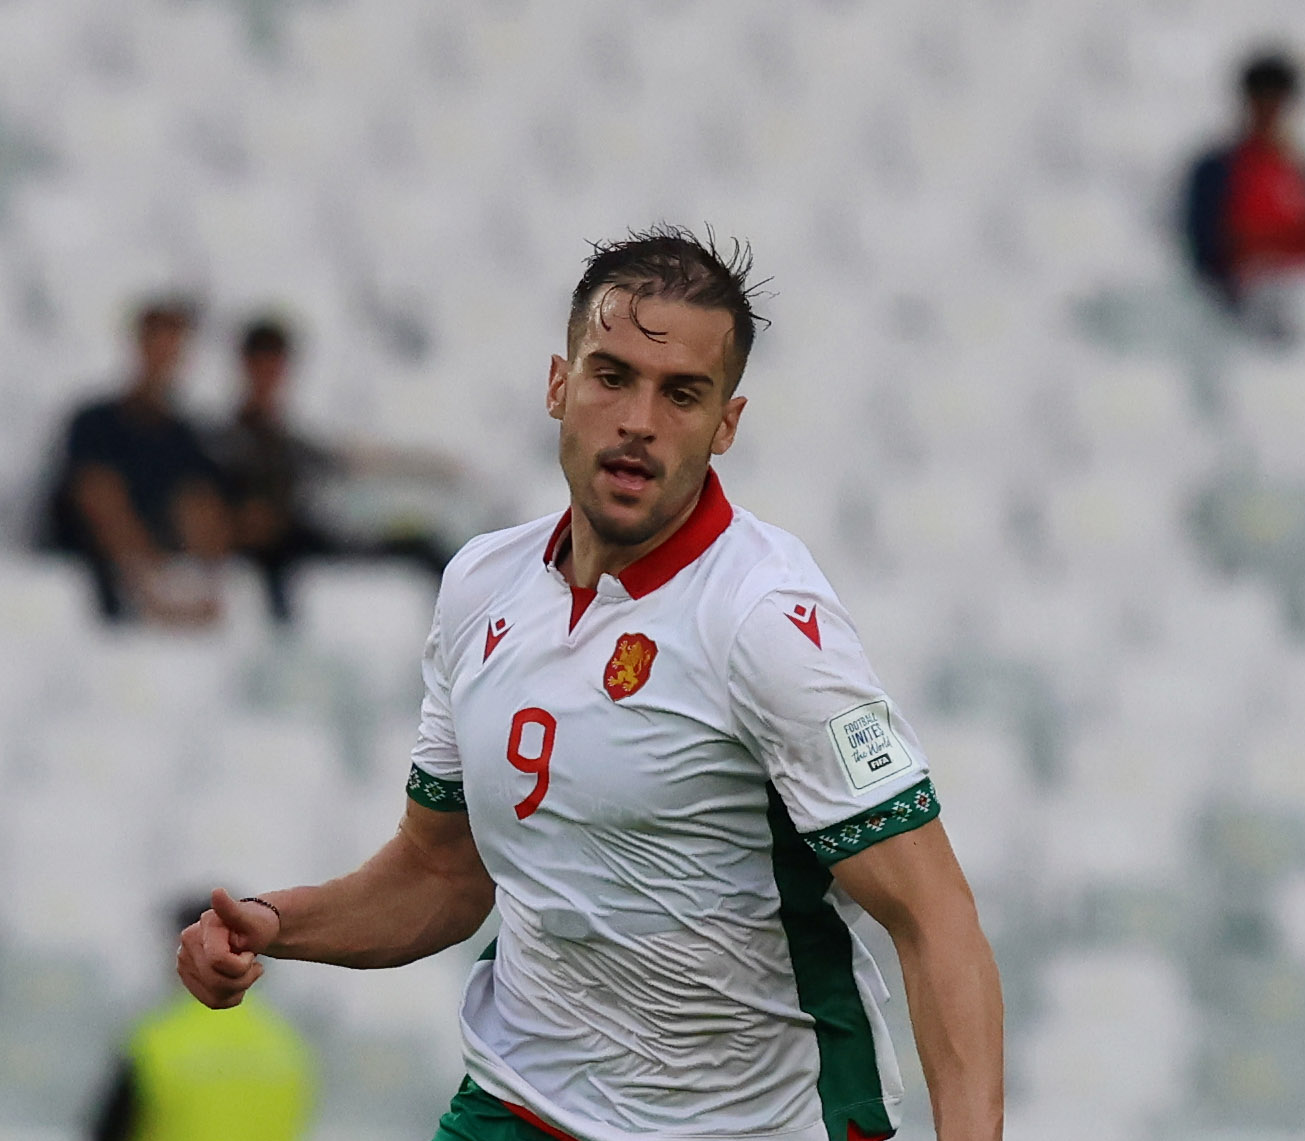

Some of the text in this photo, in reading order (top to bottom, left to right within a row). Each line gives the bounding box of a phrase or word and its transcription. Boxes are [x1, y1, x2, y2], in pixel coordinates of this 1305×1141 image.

[843, 712, 878, 735] FOOTBALL
[848, 723, 884, 749] UNITES
[507, 707, 557, 821] 9
[870, 756, 890, 769] FIFA
